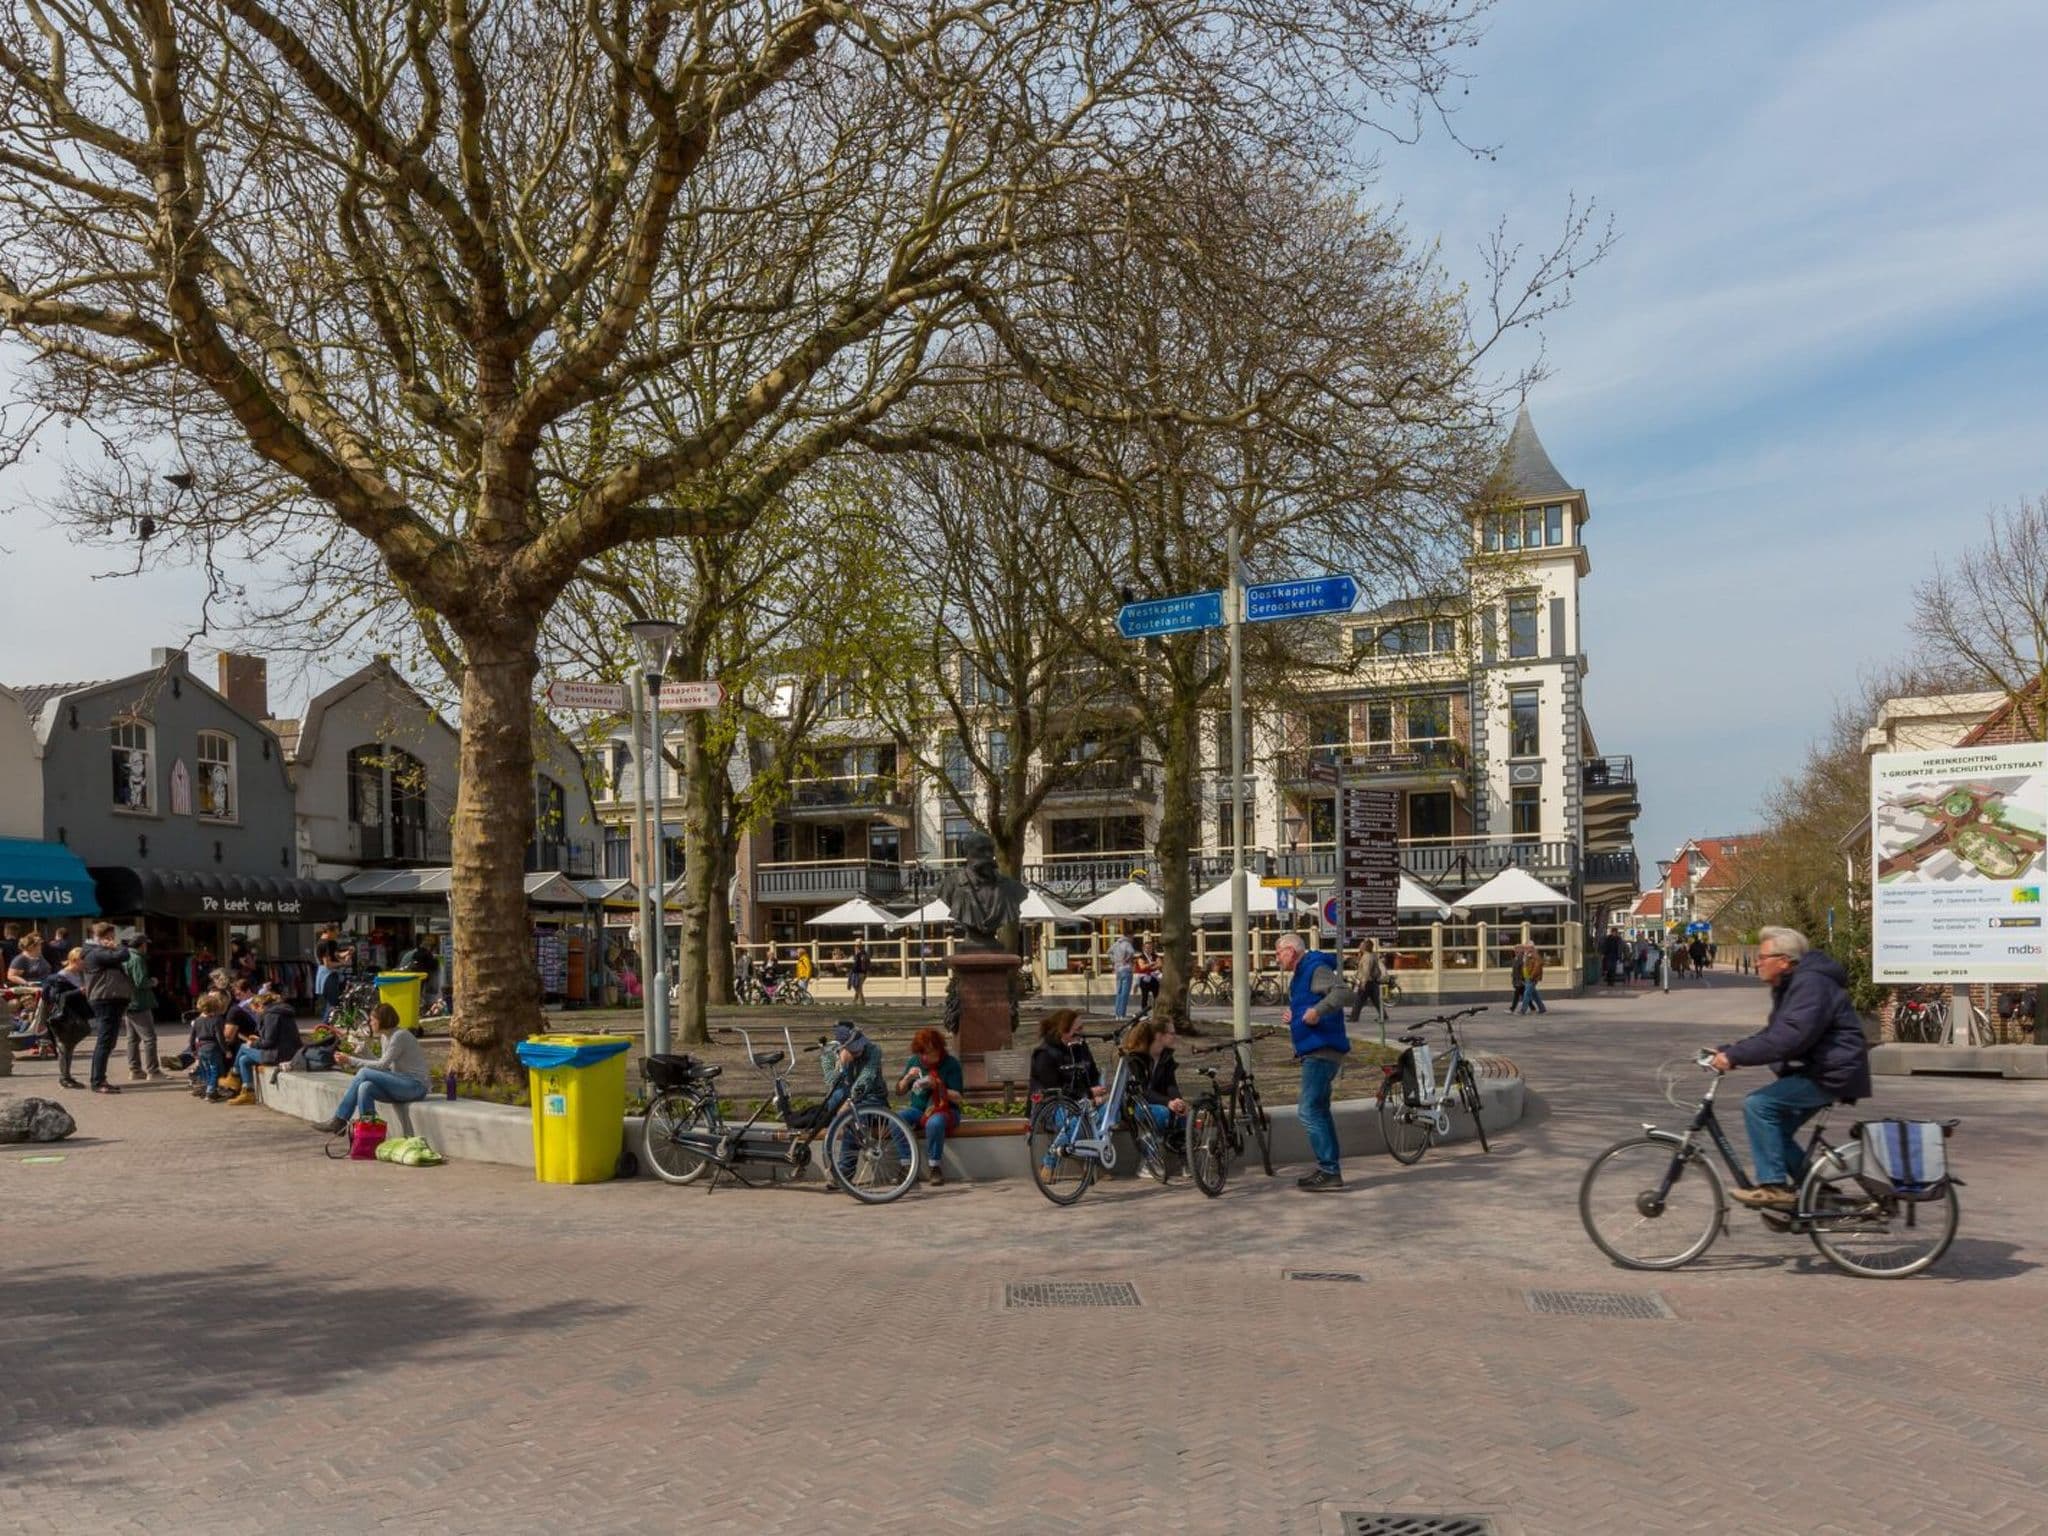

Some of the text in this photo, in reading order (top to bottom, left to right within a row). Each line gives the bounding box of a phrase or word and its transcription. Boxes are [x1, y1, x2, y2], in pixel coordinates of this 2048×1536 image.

[1251, 585, 1322, 600] Oostkapelle
[1127, 600, 1196, 618] Westkapelle
[1251, 598, 1325, 614] Serooskerke
[1128, 616, 1192, 631] Zoutelande
[662, 687, 702, 696] stkapelle
[1923, 755, 1998, 766] HERINRICHTING
[2, 885, 73, 905] Zeevis
[202, 896, 219, 911] De
[255, 901, 274, 913] van
